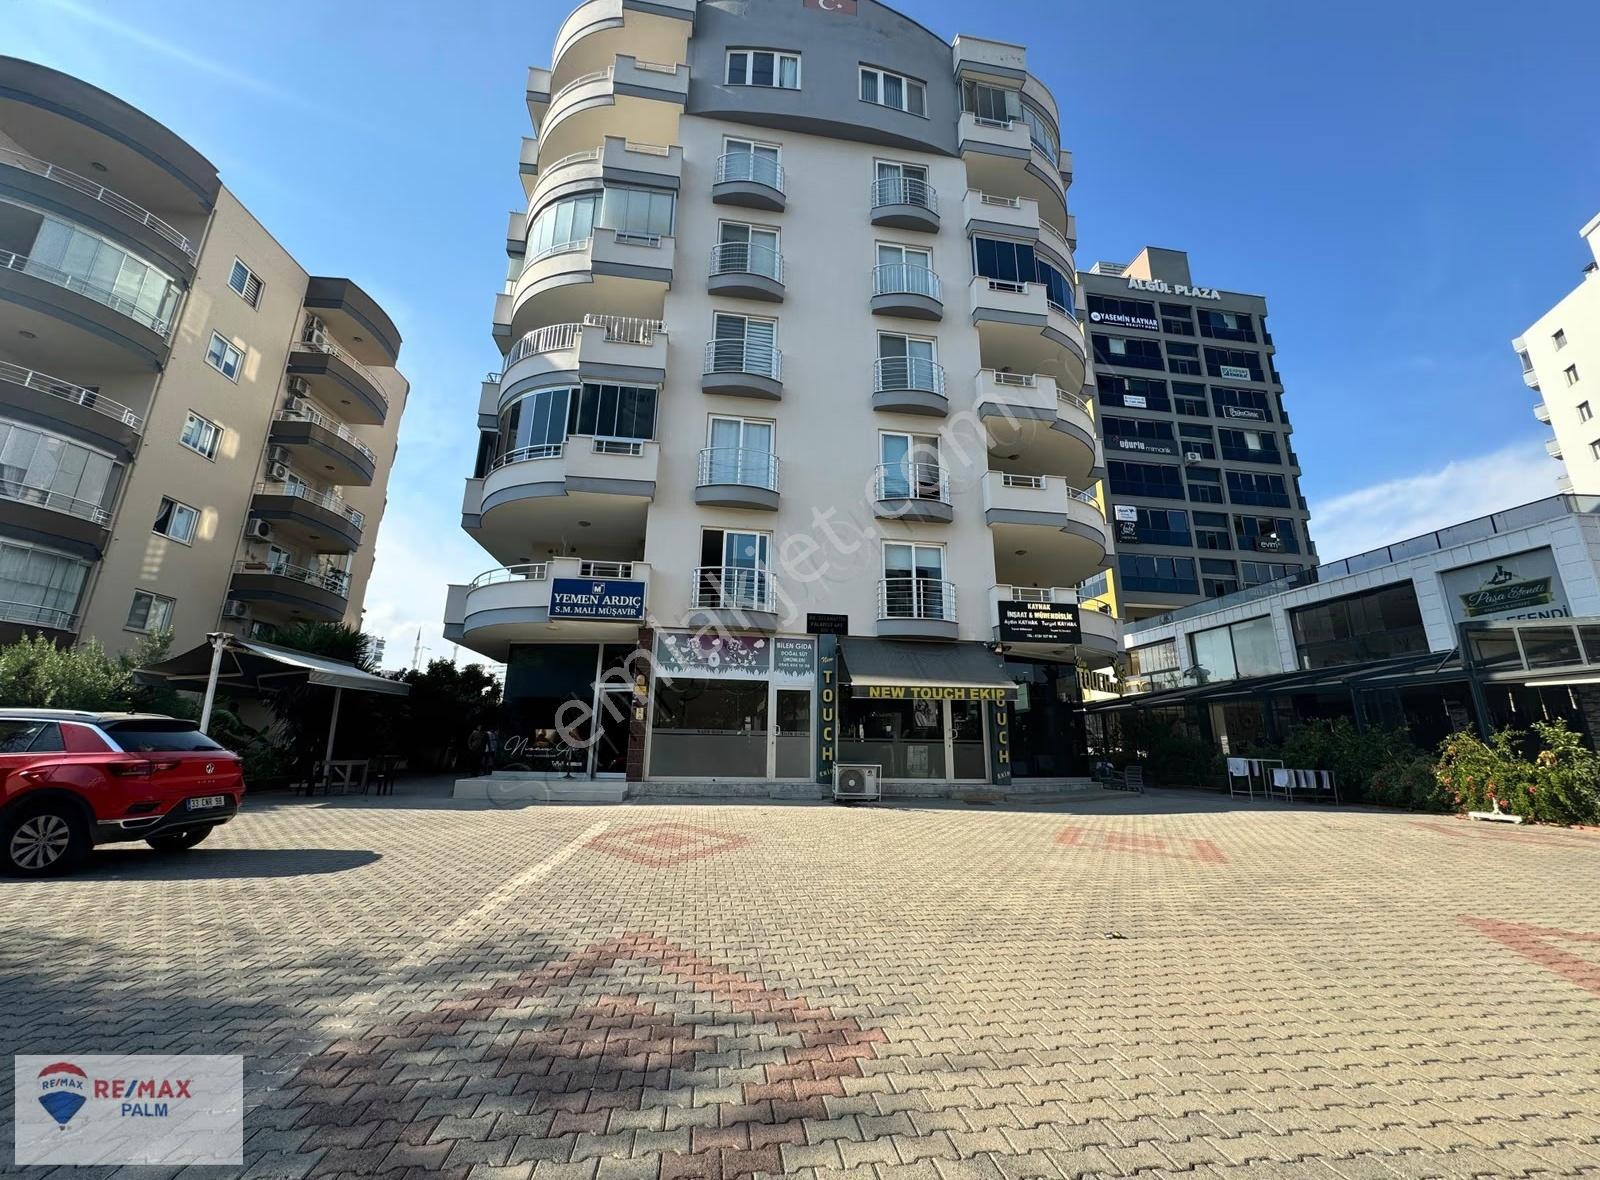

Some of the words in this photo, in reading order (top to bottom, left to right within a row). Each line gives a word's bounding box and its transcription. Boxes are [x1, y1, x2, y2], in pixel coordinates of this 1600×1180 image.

[1128, 279, 1172, 294] ALGÜL
[1174, 284, 1221, 300] PLAZA
[1099, 312, 1131, 323] YASEMİN
[1131, 316, 1158, 327] KAYNAR
[554, 593, 599, 604] YEMEN
[602, 595, 641, 608] ARDIÇ
[555, 606, 573, 614] S.M.
[869, 687, 906, 698] NEW
[911, 688, 965, 700] TOUCH
[192, 799, 199, 808] 33
